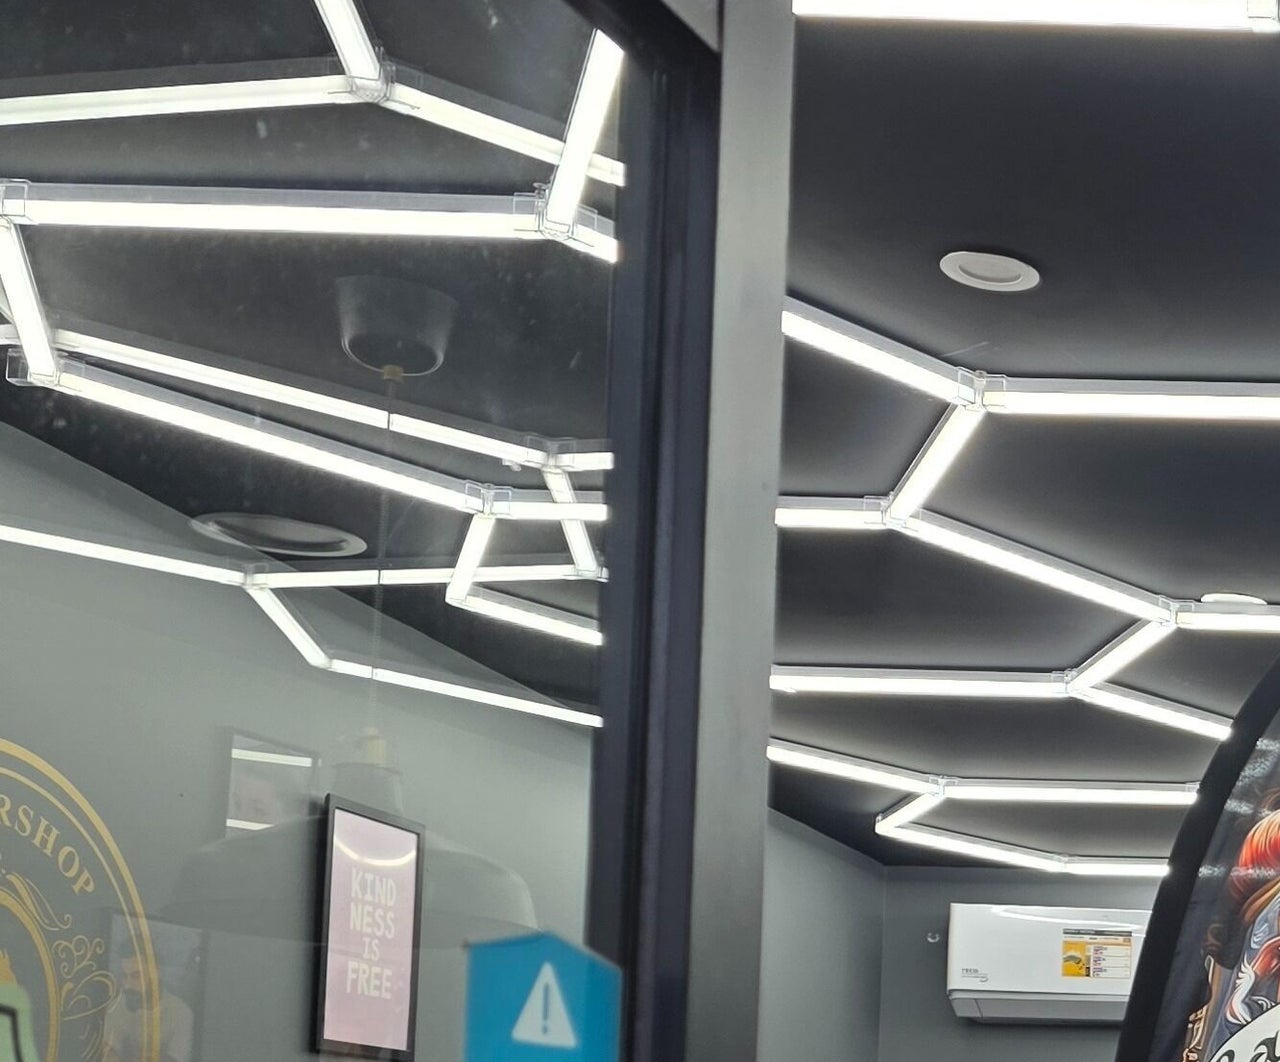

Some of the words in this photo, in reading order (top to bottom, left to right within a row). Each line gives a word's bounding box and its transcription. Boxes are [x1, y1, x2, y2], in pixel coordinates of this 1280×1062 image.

[351, 867, 397, 907] KIND
[350, 902, 395, 939] NESS
[362, 937, 380, 961] IS
[346, 961, 393, 1000] FREE
